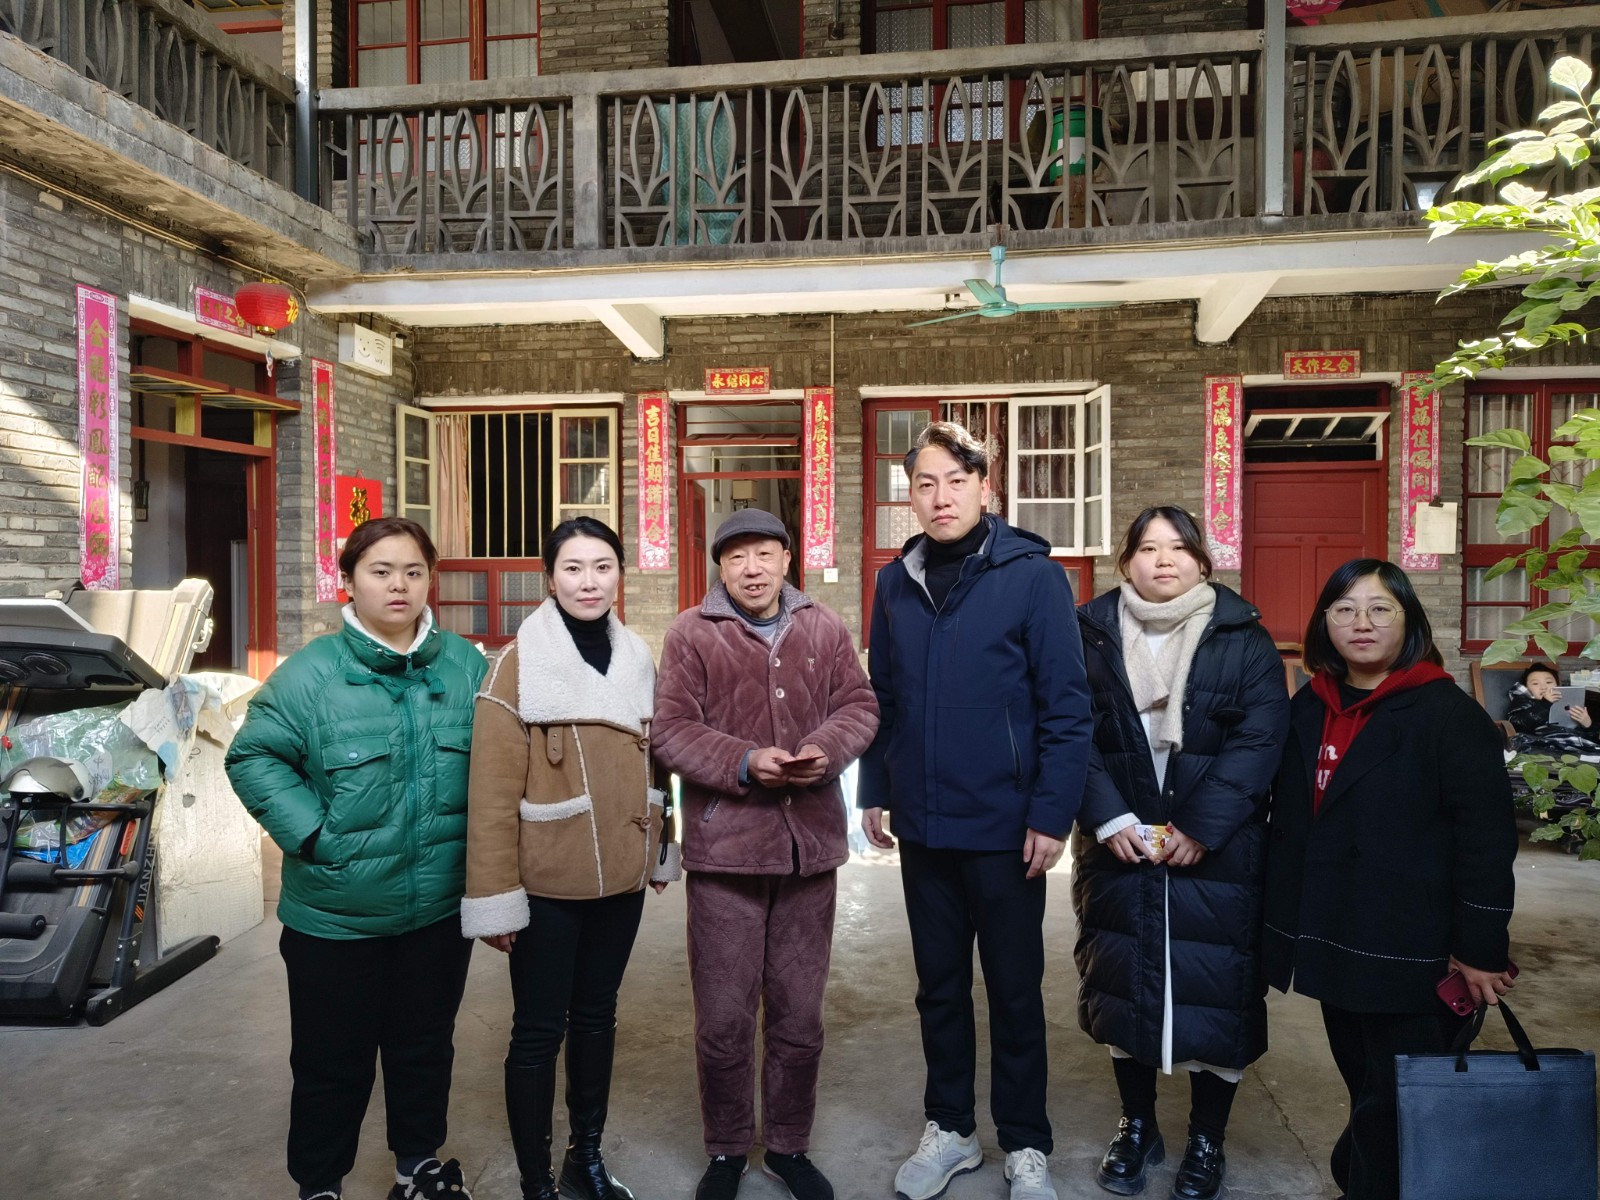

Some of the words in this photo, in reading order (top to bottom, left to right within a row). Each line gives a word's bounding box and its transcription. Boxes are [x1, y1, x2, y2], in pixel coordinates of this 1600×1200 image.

[1292, 357, 1352, 373] 天作之合
[1410, 385, 1432, 528] 幸福佳偶同
[349, 486, 370, 527] 福
